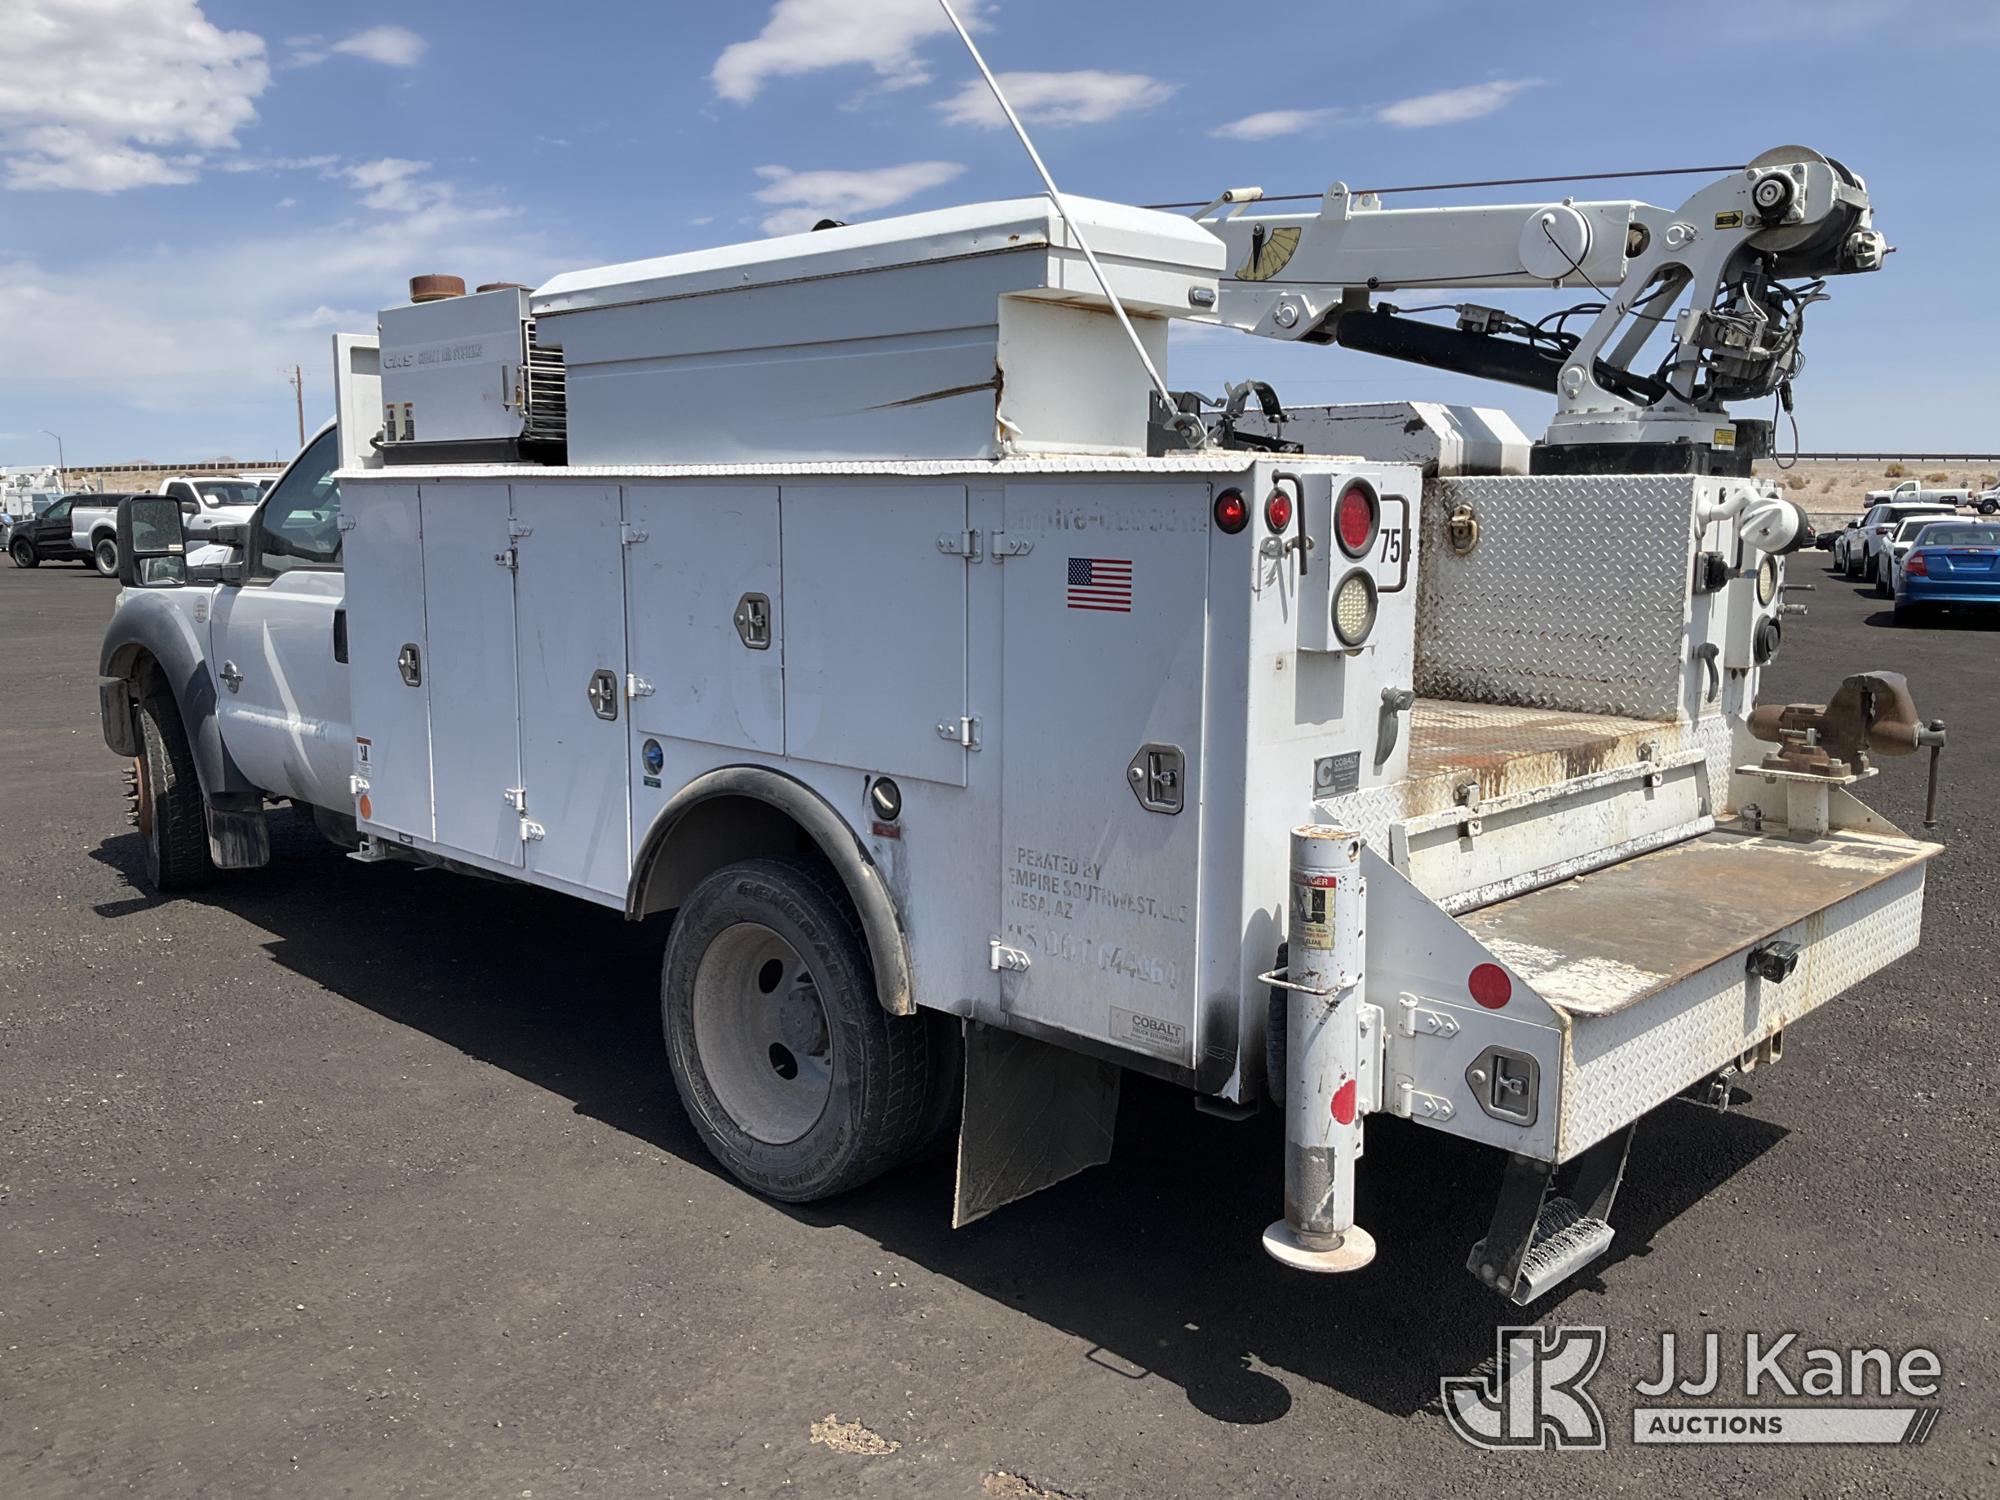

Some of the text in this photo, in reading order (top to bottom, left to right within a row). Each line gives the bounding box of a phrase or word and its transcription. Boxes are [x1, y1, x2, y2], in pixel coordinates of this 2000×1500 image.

[1380, 529, 1411, 563] 75
[1008, 867, 1060, 894] EMPIRE
[1063, 879, 1157, 919] SOUTHWEST,
[1055, 900, 1073, 920] AZ
[1132, 1015, 1181, 1036] COBALT
[1133, 1026, 1149, 1036] TRUCK
